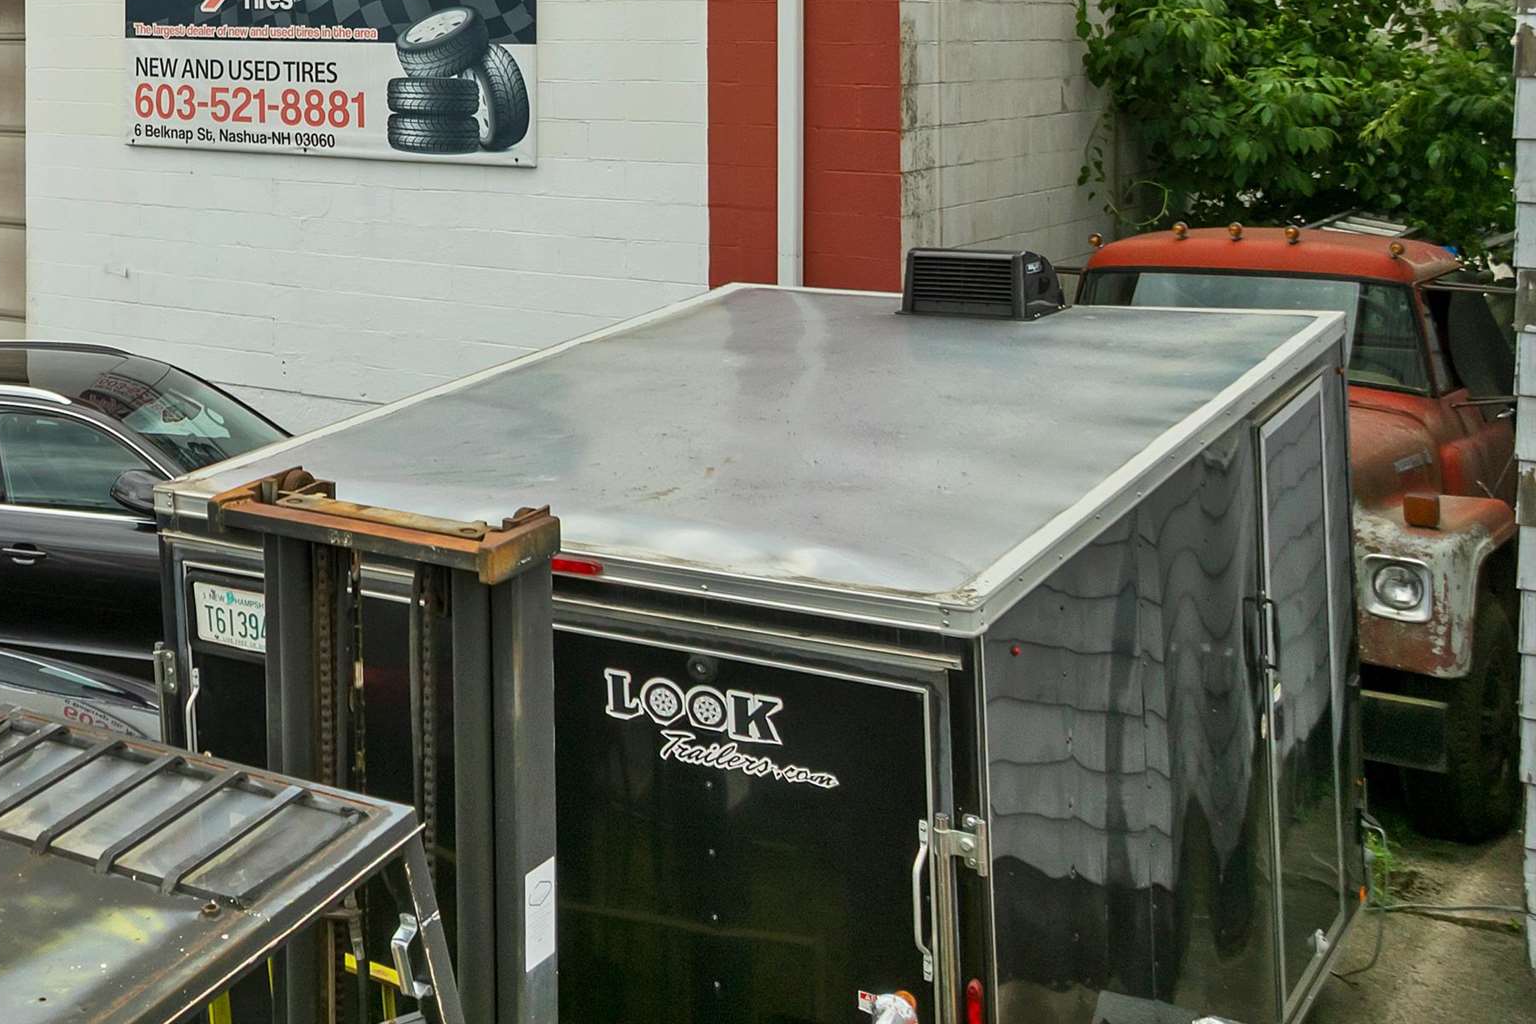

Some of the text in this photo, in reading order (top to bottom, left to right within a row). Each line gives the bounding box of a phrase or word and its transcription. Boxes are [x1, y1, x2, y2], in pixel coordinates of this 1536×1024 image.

[134, 23, 378, 40] The largest dealer of new and used tires in the area
[135, 57, 338, 83] NEW AND USED TIRES
[134, 82, 366, 129] 603-521-8881
[134, 123, 336, 148] 6 Belknap St, Nashua-NH 03060
[604, 668, 784, 745] LOOK
[660, 730, 840, 789] Trailers.com
